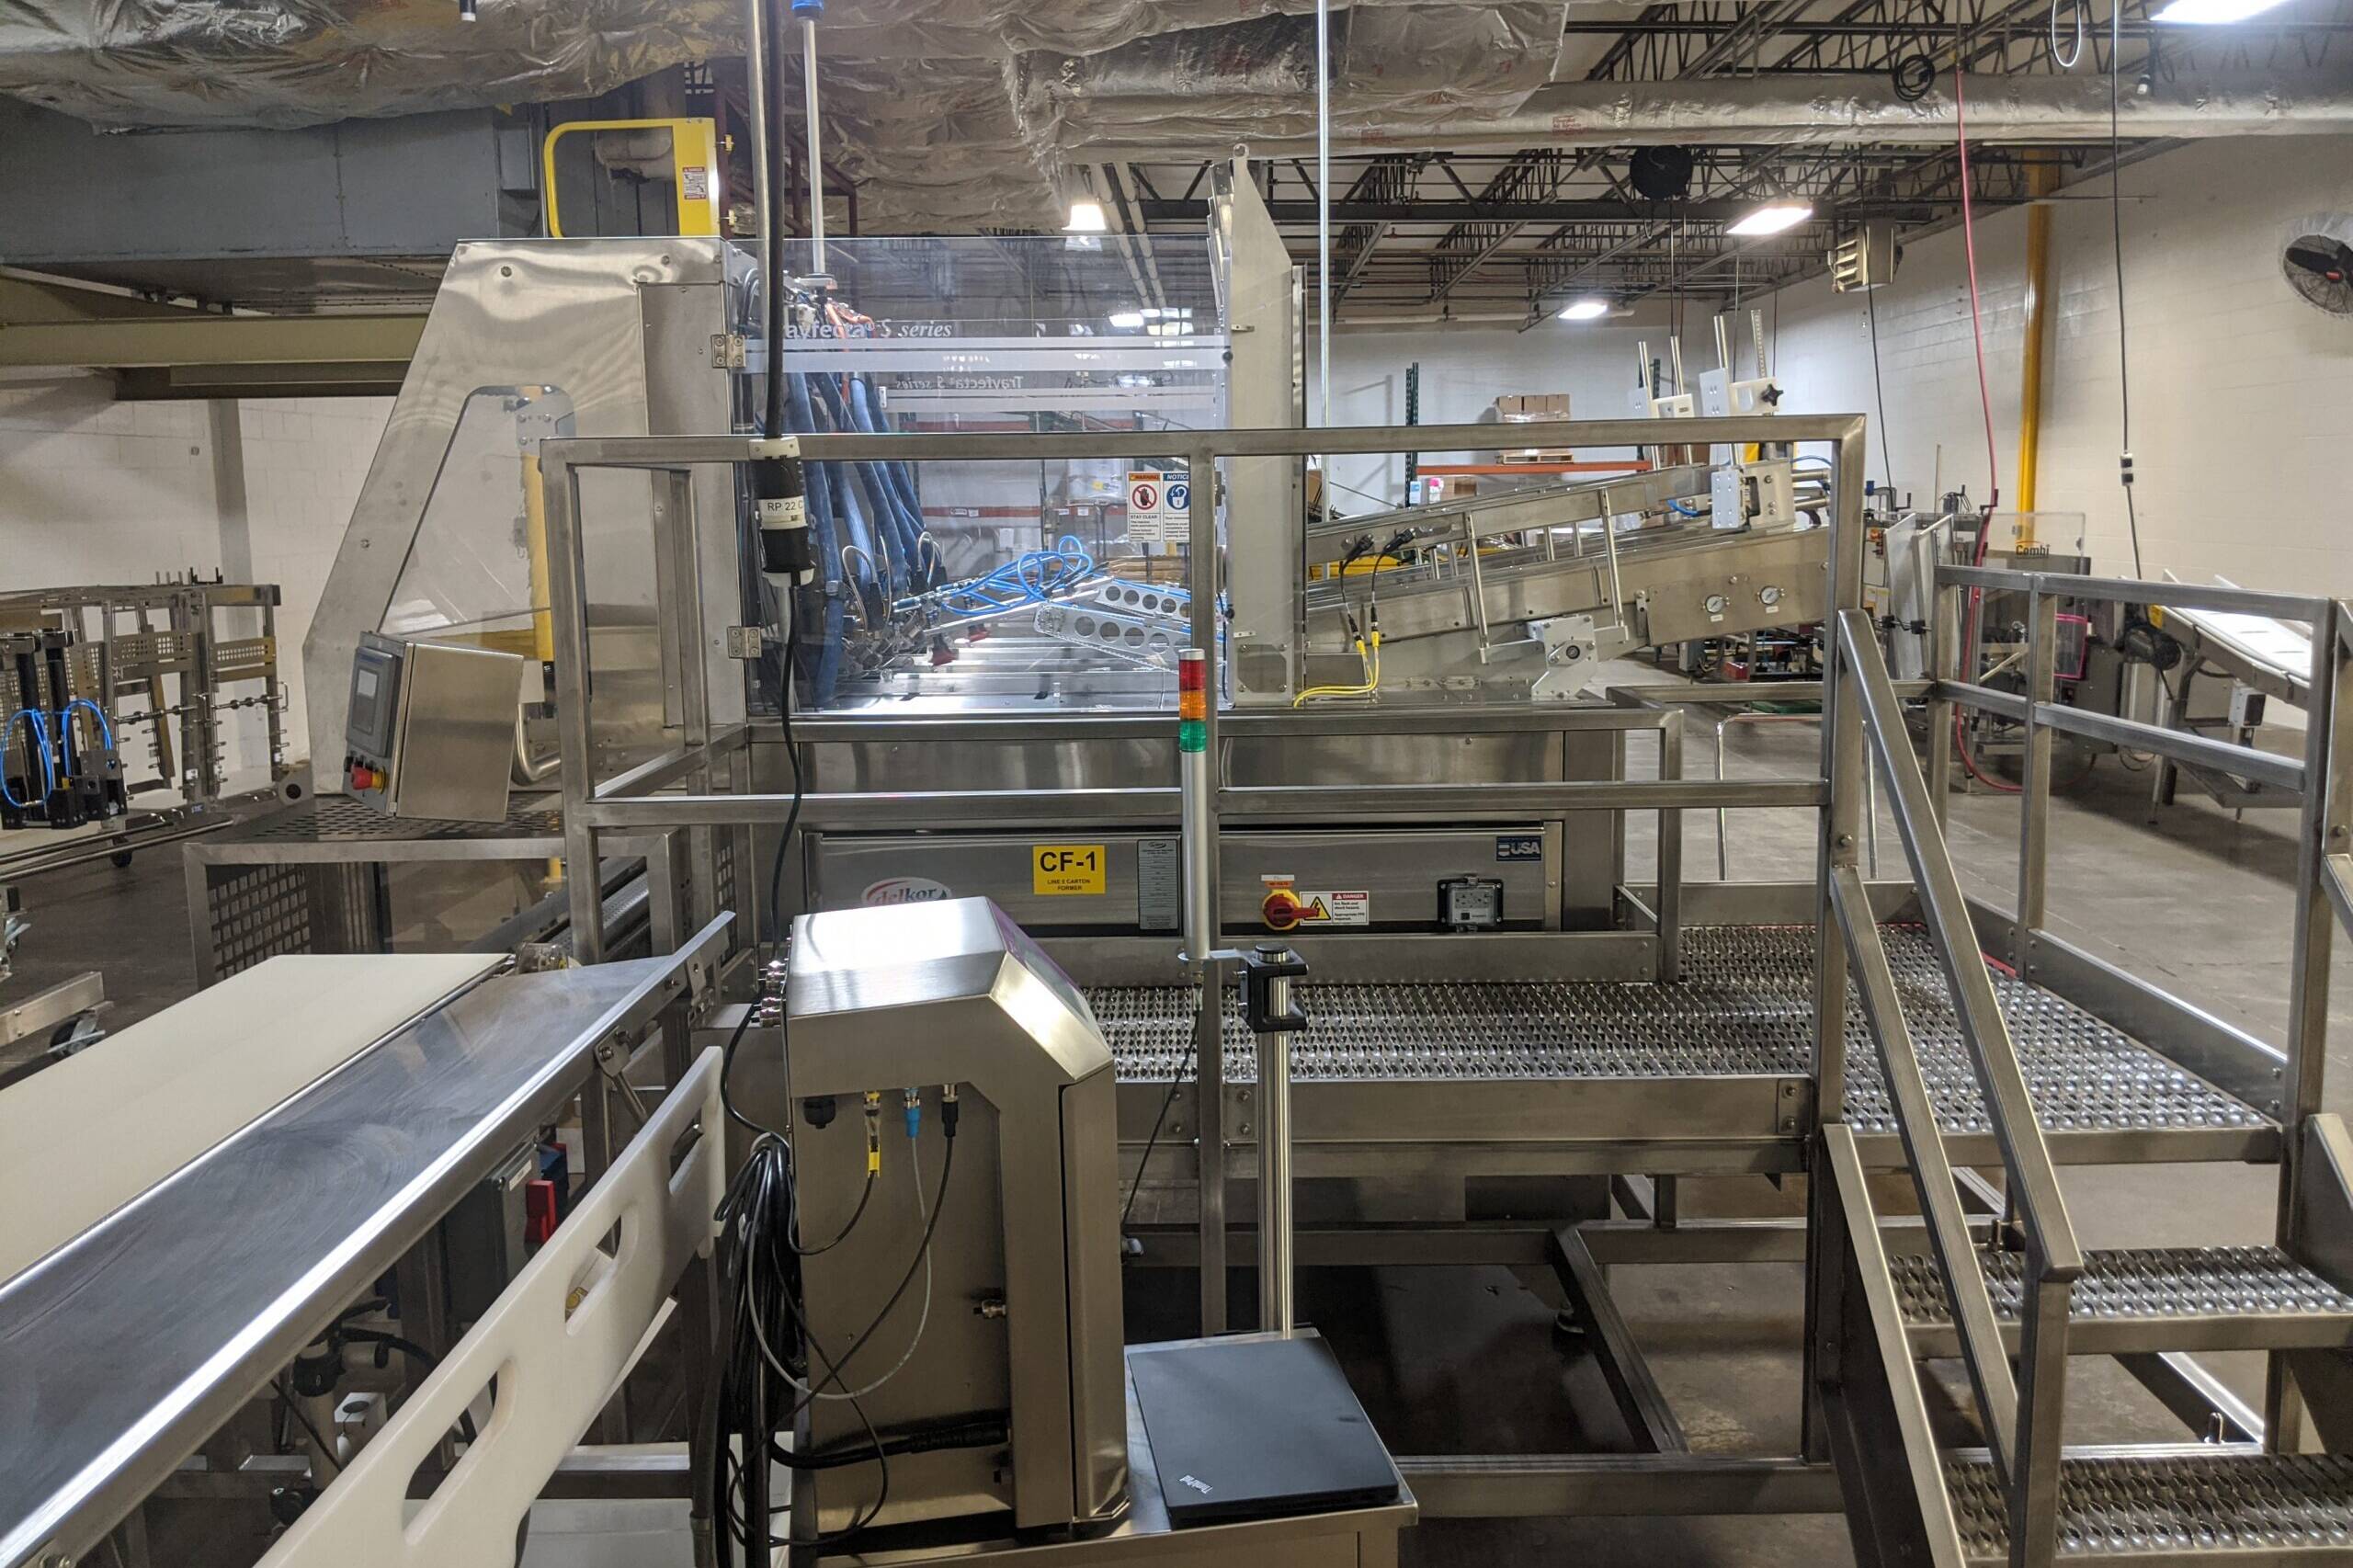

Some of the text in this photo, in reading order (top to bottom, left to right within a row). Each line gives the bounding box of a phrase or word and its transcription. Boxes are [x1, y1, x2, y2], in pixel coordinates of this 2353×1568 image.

[900, 321, 952, 337] series
[767, 502, 781, 511] RP
[785, 501, 797, 511] 22
[2016, 544, 2051, 556] Combi
[1509, 841, 1540, 854] USA
[1040, 851, 1096, 872] CF-1
